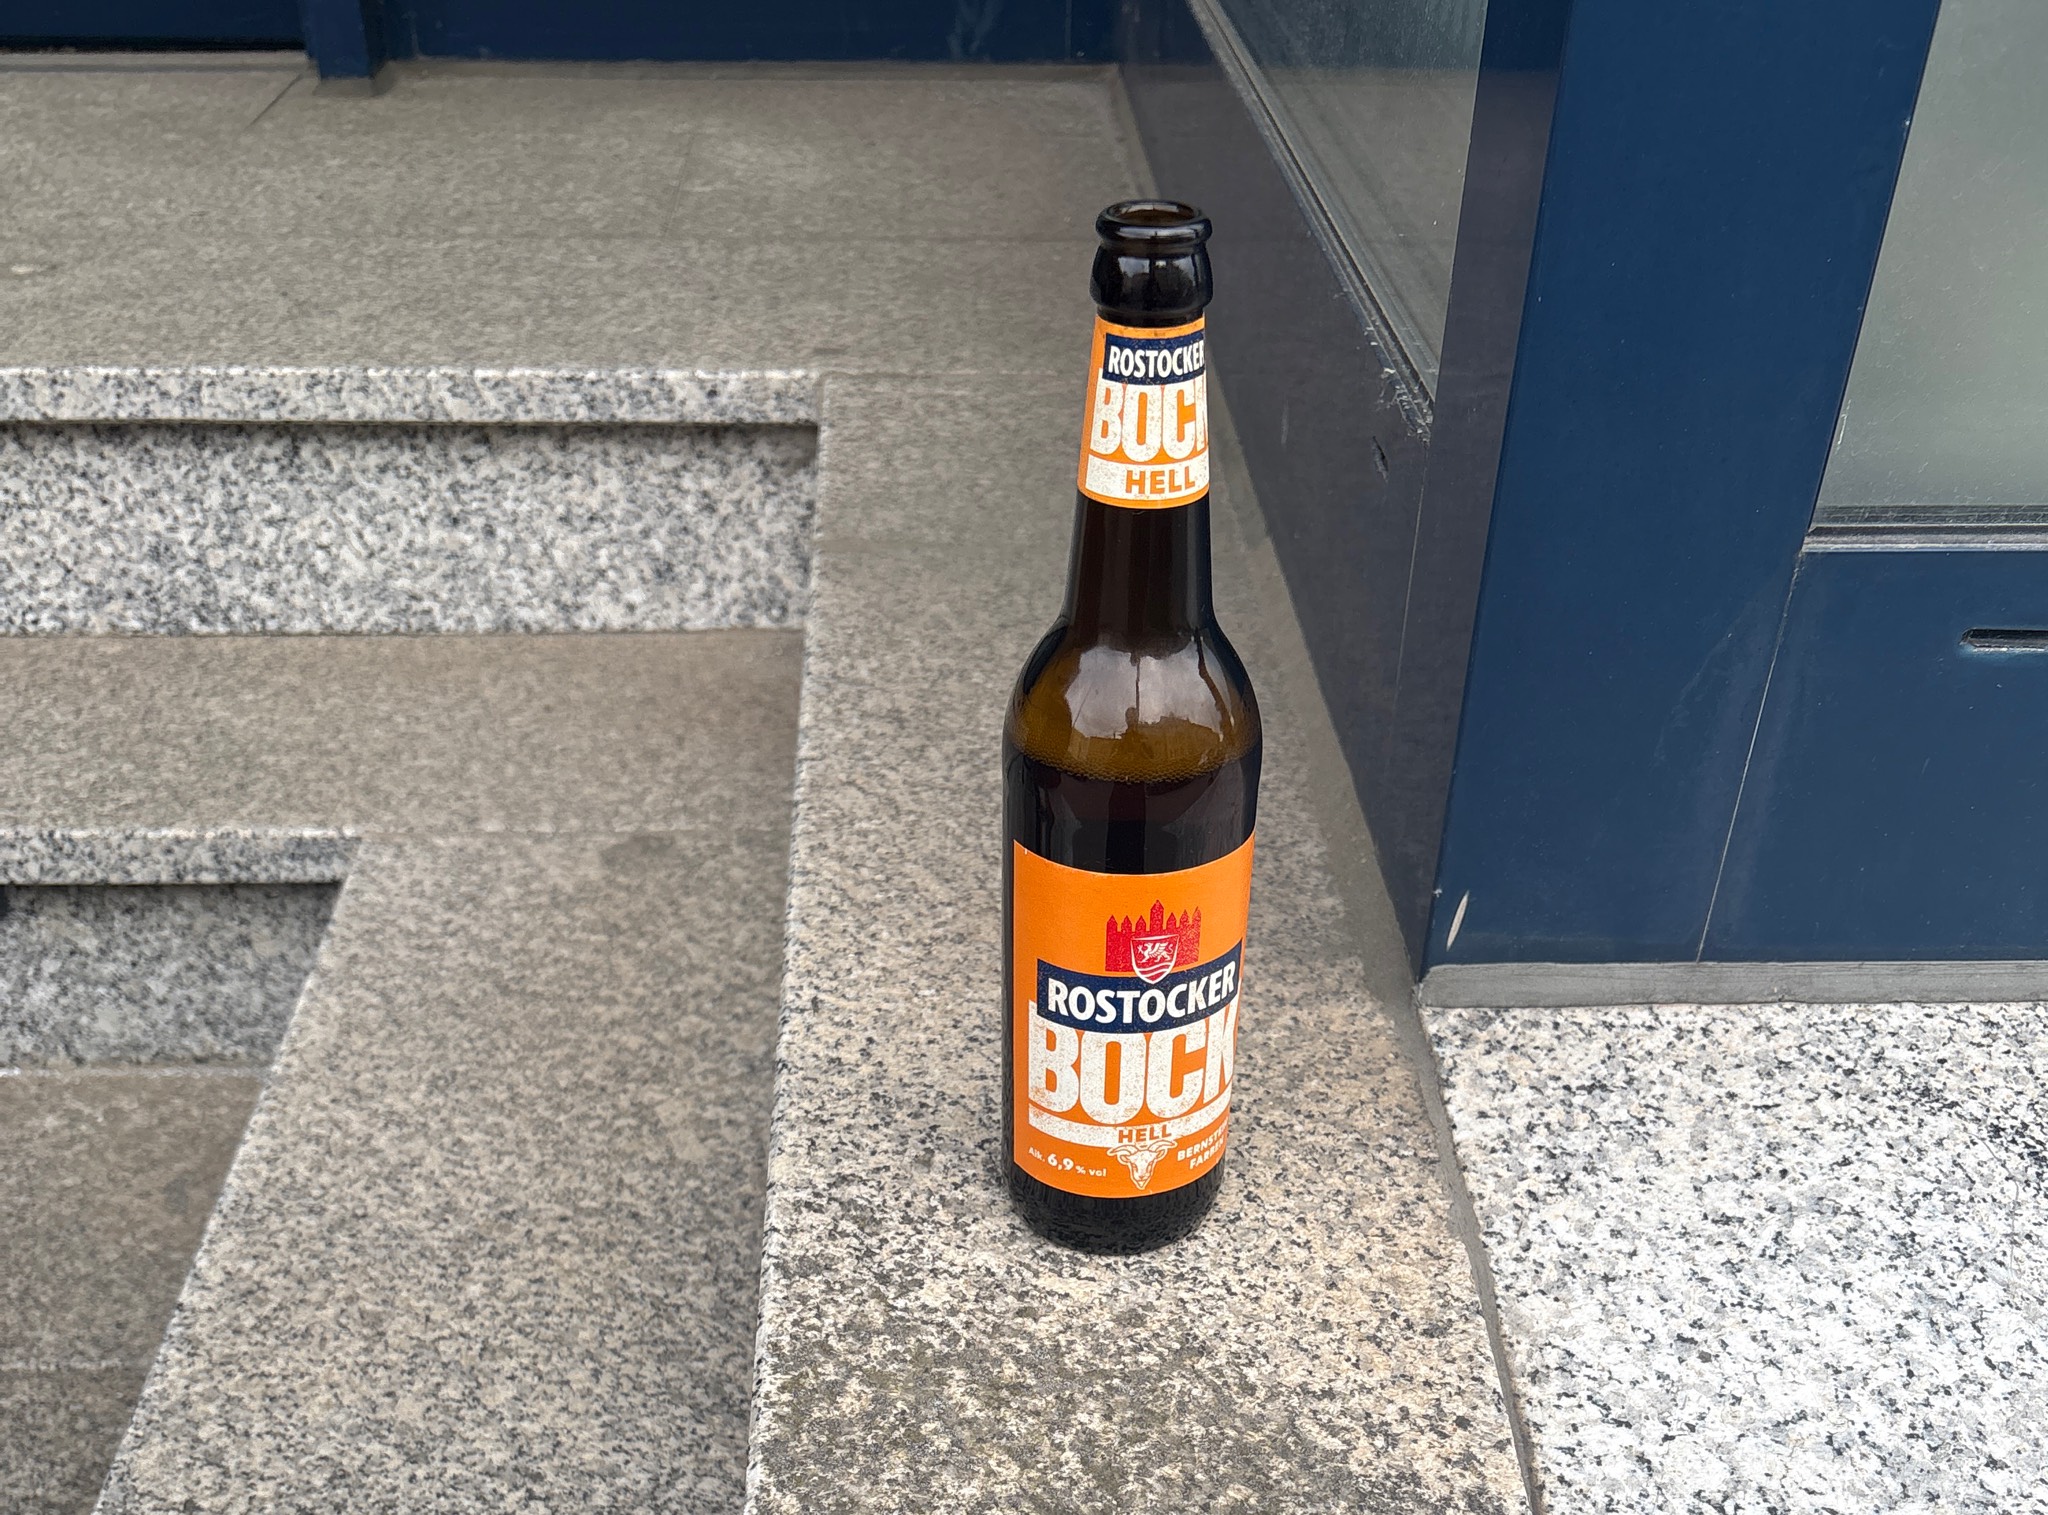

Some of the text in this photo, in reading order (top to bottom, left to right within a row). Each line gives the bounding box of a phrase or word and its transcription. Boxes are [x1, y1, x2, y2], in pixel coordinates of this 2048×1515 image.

[1126, 466, 1195, 494] HELL
[1048, 961, 1236, 1024] ROSTOCKER
[1028, 998, 1238, 1124] BOCK
[1118, 1124, 1172, 1143] HELL
[1028, 1146, 1046, 1162] Alk.
[1047, 1153, 1074, 1171] 6,9
[1089, 1168, 1107, 1177] vol
